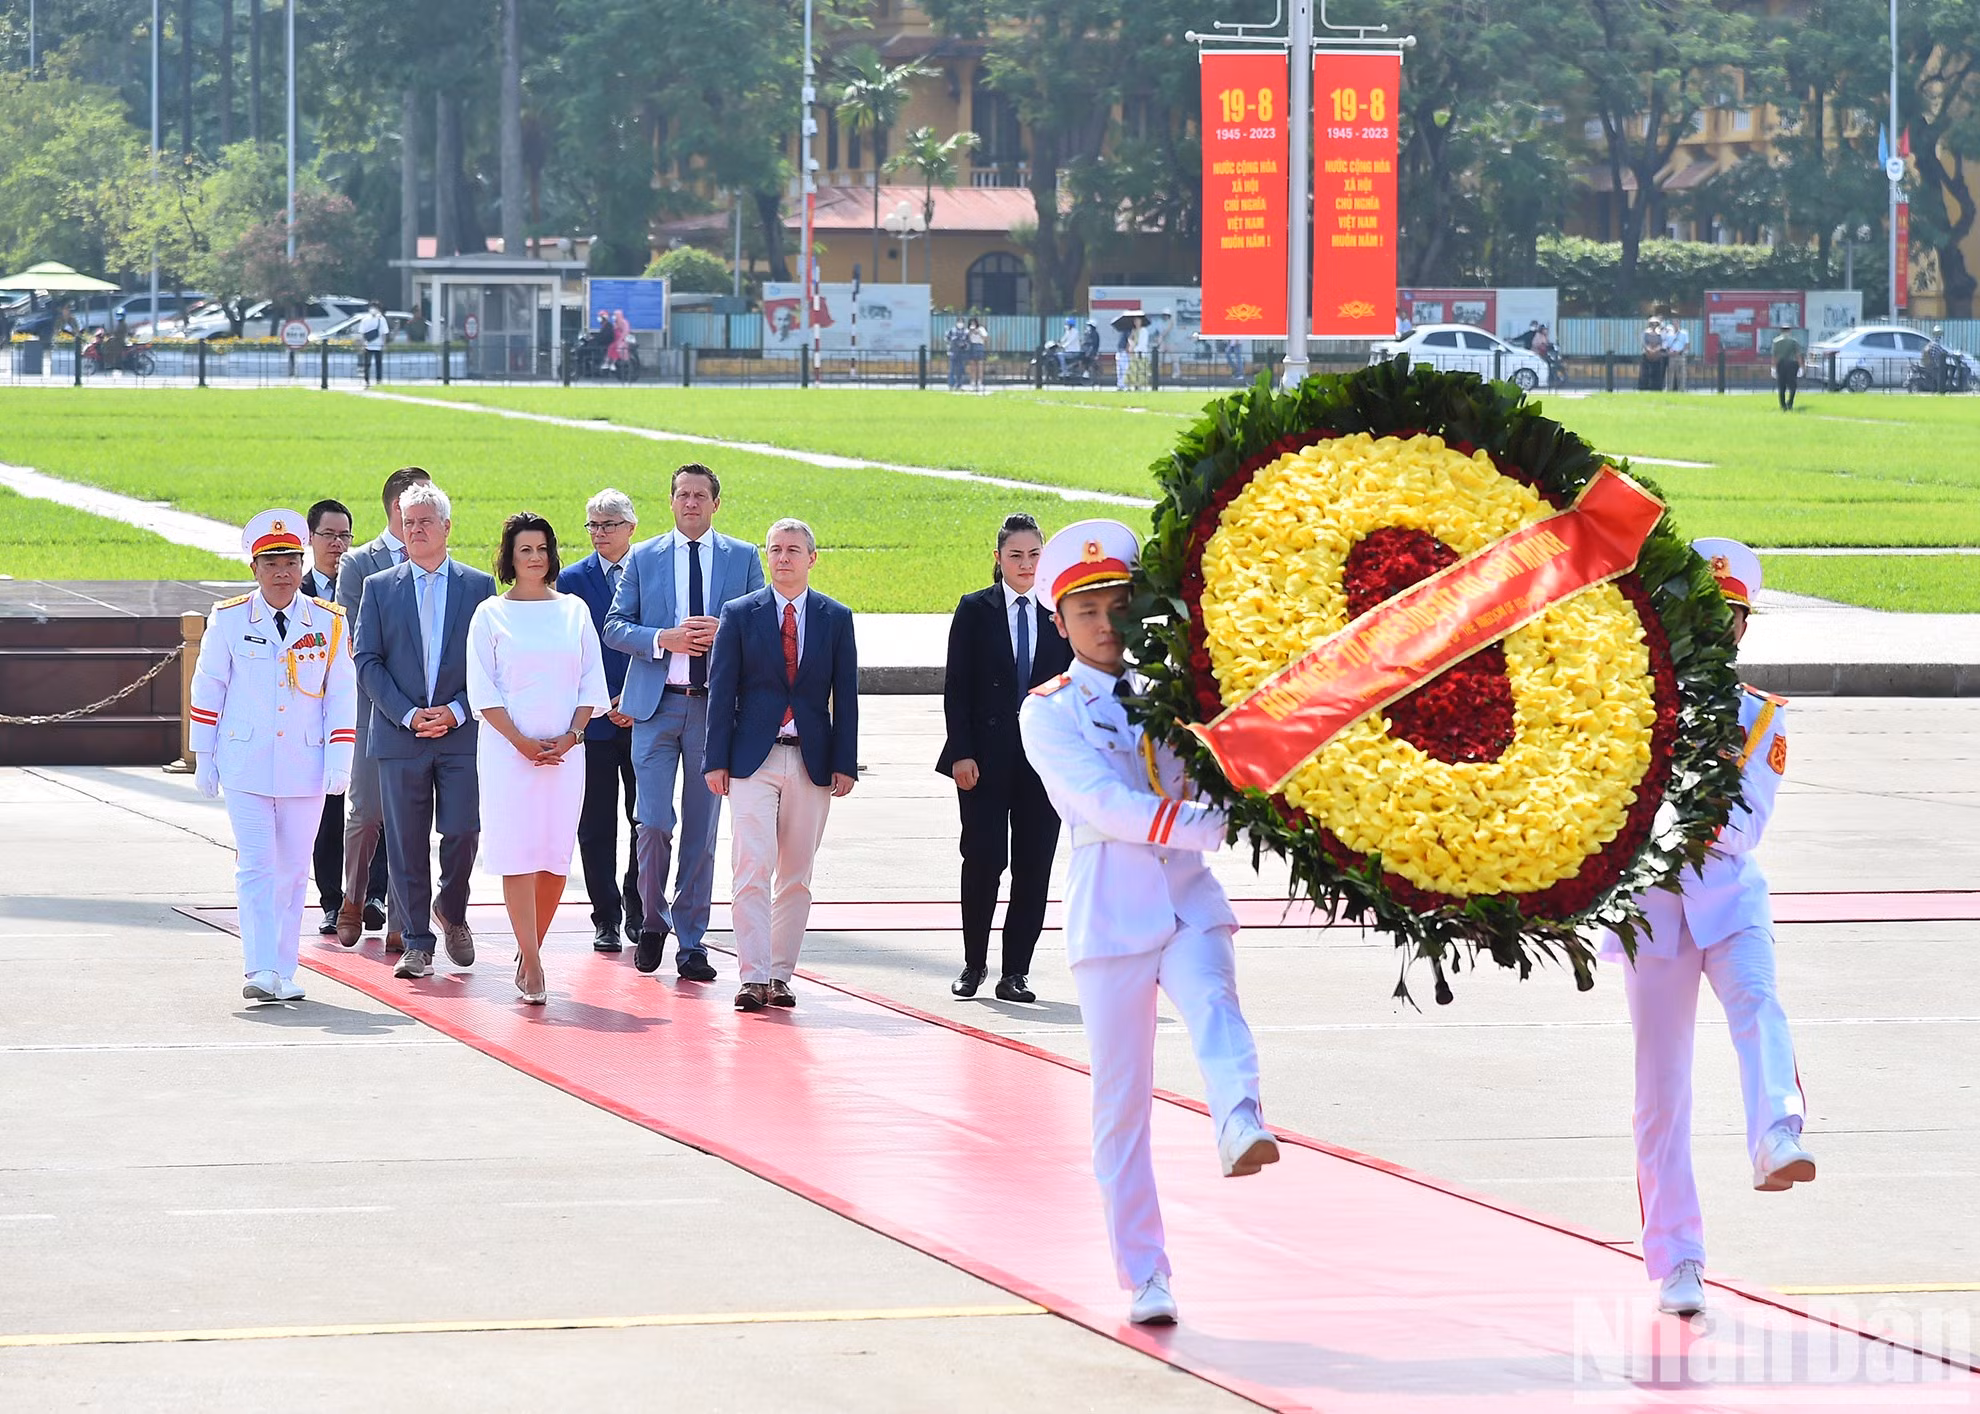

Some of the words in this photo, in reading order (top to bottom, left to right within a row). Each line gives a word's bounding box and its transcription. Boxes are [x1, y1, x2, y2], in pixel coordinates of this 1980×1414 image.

[1219, 88, 1273, 122] 19-8
[1331, 88, 1385, 122] 19-8
[1216, 128, 1241, 140] 1945
[1249, 127, 1276, 139] 2023
[1328, 127, 1353, 139] 1945
[1362, 127, 1388, 139] 2023
[1236, 159, 1259, 176] CỘNG
[1349, 158, 1373, 175] CỘNG
[1244, 177, 1259, 194] HỘI
[1358, 177, 1372, 193] HỘI
[1224, 194, 1239, 211] CHỦ
[1241, 196, 1266, 211] NGHĨA
[1336, 193, 1353, 210] CHỦ
[1354, 195, 1380, 210] NGHĨA
[1227, 215, 1243, 232] VIỆT
[1245, 217, 1264, 229] NAM
[1338, 214, 1356, 231] VIỆT
[1357, 216, 1377, 229] NAM
[1221, 234, 1245, 249] MUÔN
[1246, 233, 1265, 248] NĂM
[1332, 232, 1357, 247] MUÔN
[1358, 232, 1378, 247] NĂM
[1255, 656, 1348, 721] HOMAGE
[1334, 639, 1370, 669] TO
[1357, 587, 1463, 656] PRESIDENT
[1479, 550, 1525, 583] CHI
[1509, 530, 1571, 570] MINH
